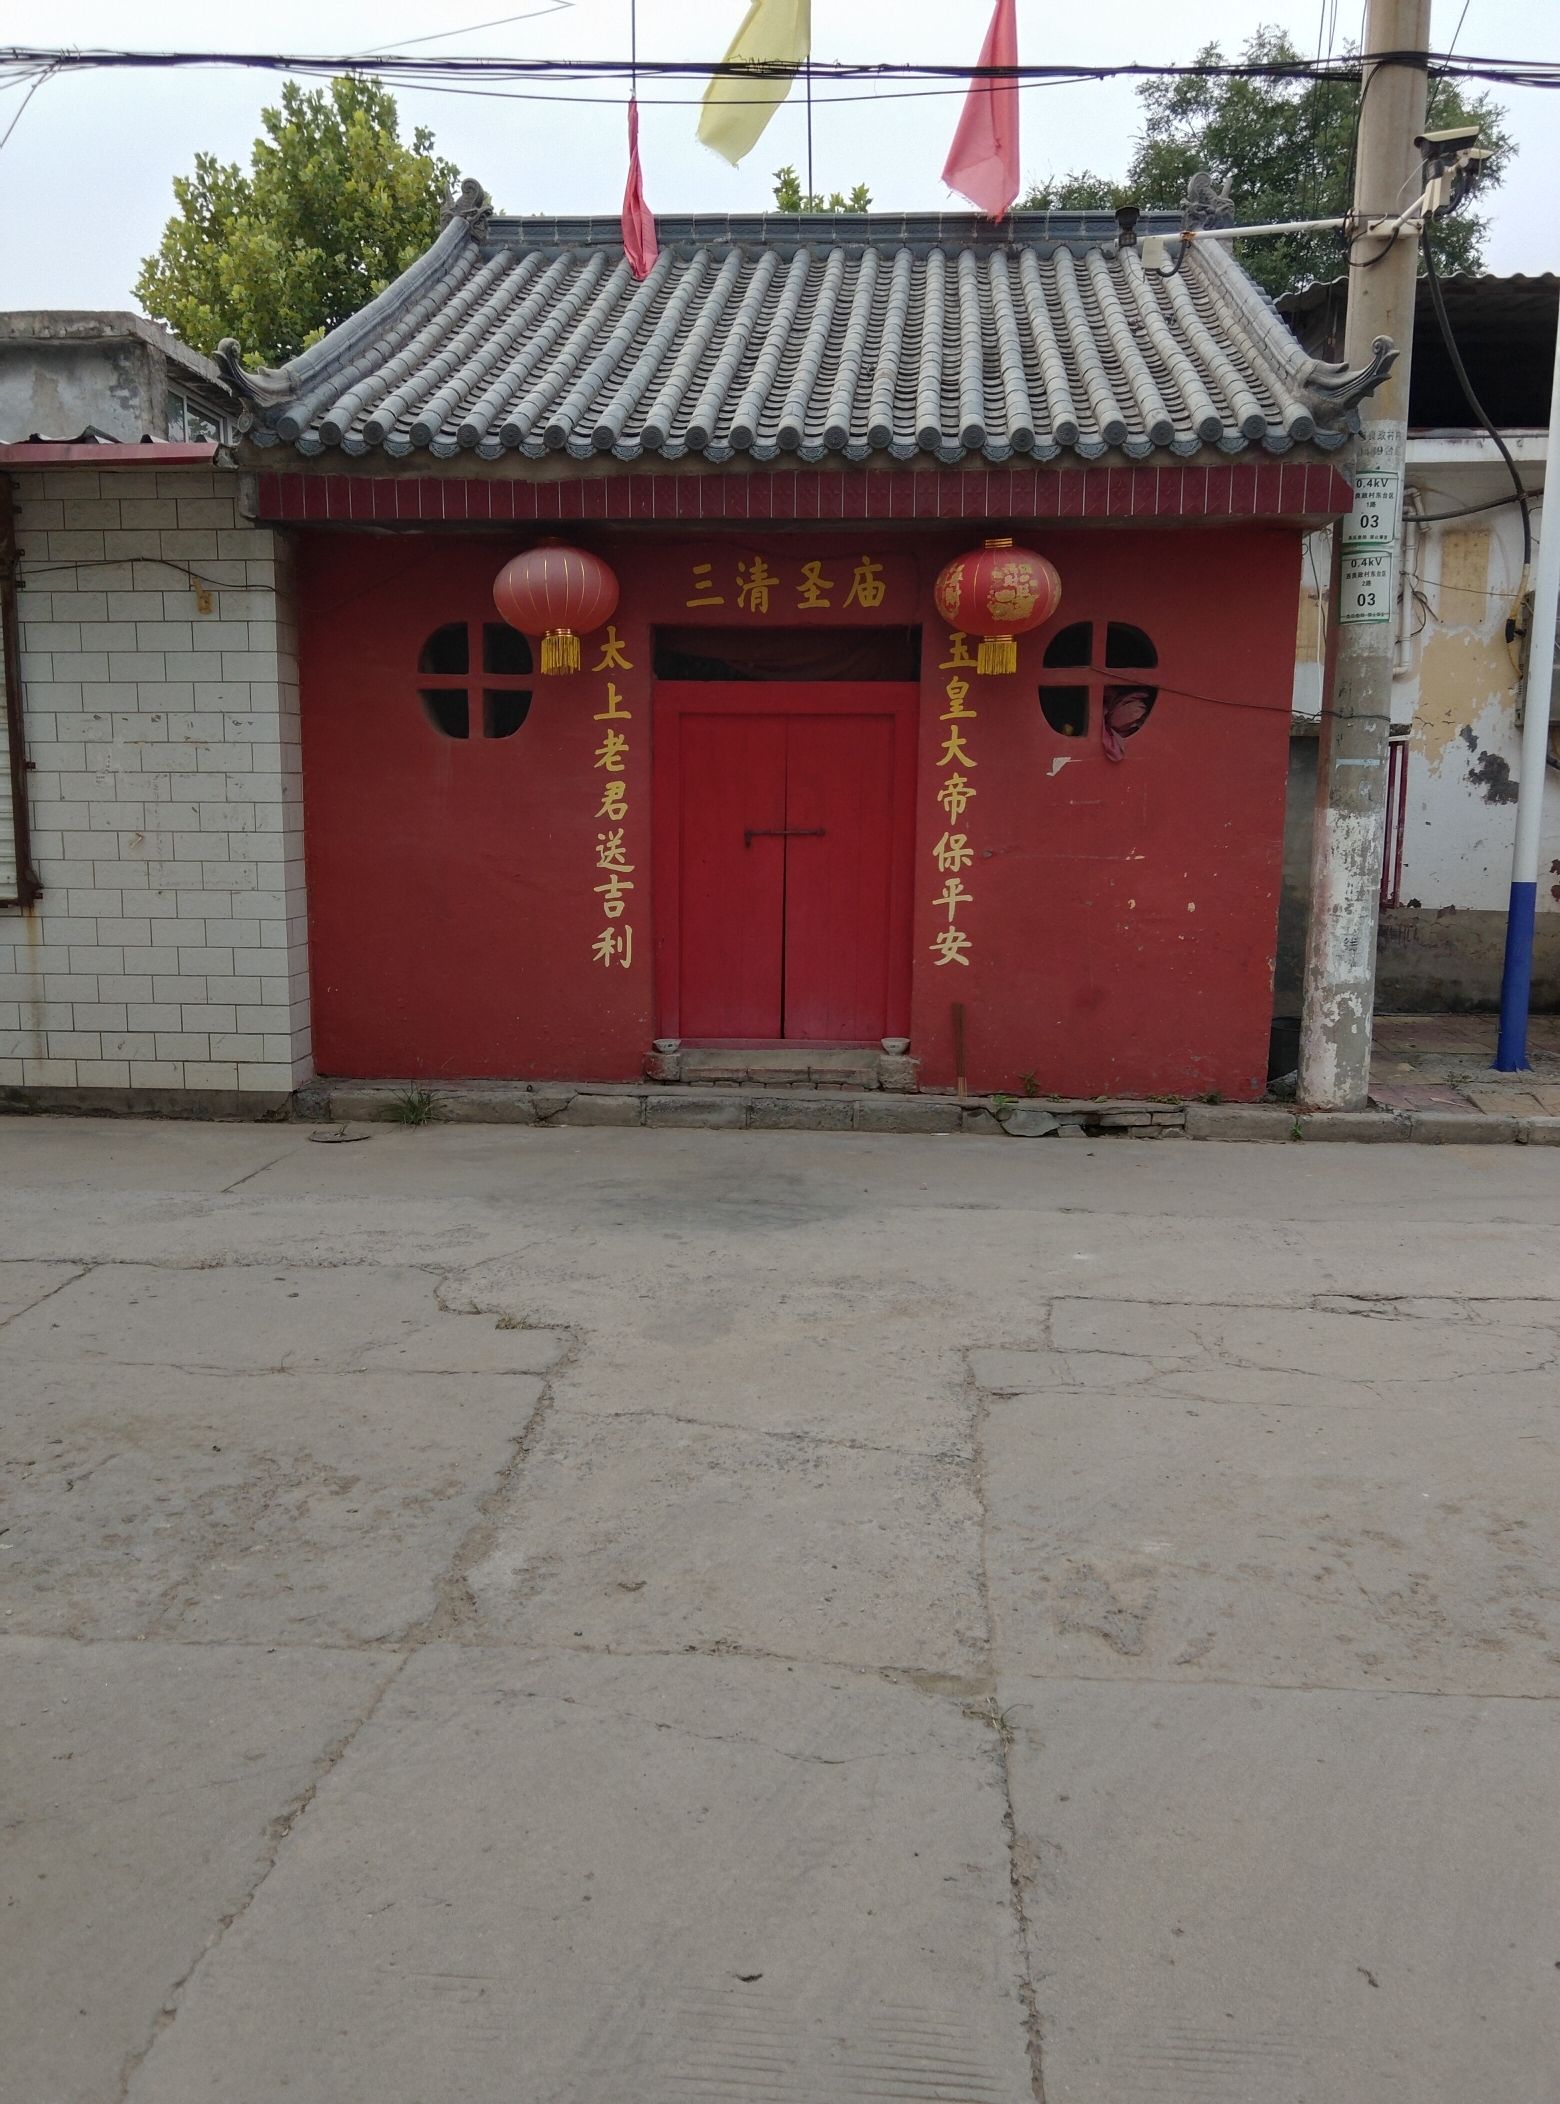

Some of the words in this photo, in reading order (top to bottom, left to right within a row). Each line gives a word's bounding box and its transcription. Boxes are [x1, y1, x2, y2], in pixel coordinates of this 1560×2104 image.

[1356, 478, 1389, 488] 0.4kV
[1360, 514, 1379, 529] 03
[1350, 557, 1383, 568] 0.4kV
[686, 556, 887, 614] 三清圣庙
[1357, 592, 1376, 607] 03
[591, 626, 635, 968] 太上老君送吉利
[929, 631, 978, 966] 玉皇大帝保平安
